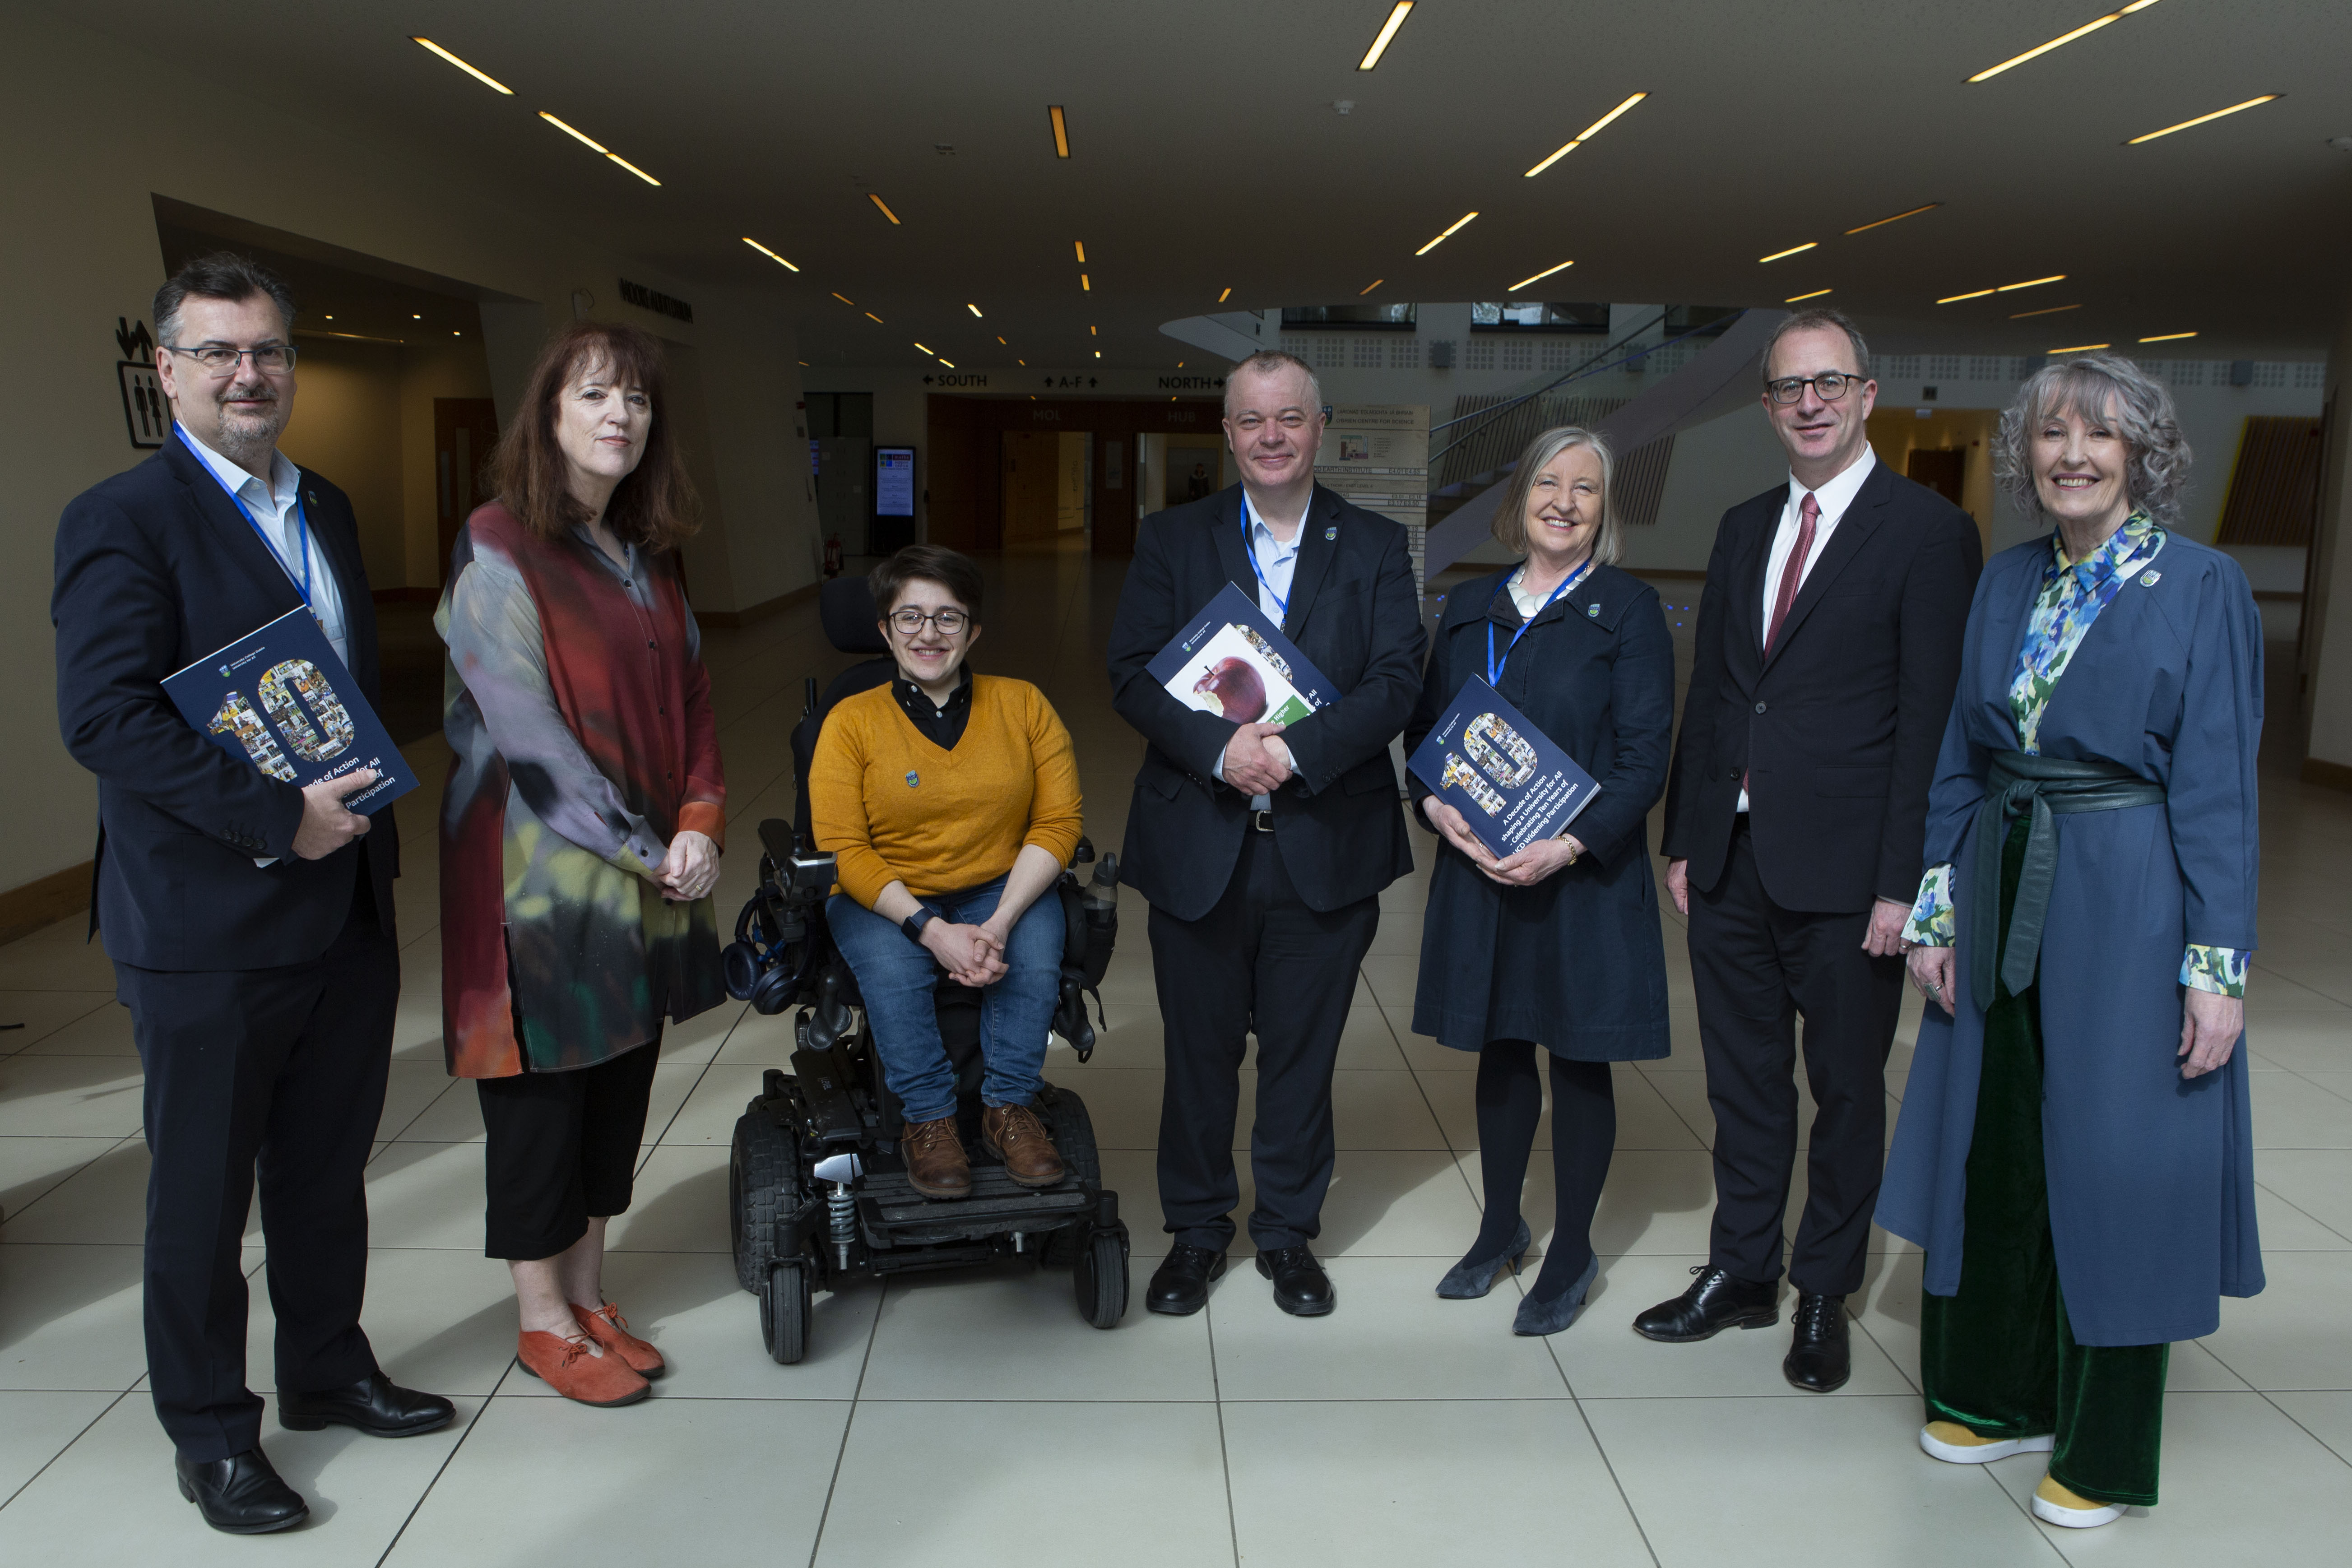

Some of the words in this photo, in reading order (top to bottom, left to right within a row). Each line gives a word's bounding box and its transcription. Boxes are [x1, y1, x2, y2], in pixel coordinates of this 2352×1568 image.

[938, 374, 987, 386] SOUTH
[1059, 376, 1082, 388] A-F
[1159, 376, 1211, 389] NORTH
[1033, 410, 1061, 421] MOL
[1168, 411, 1196, 422] HUB
[1309, 689, 1317, 699] All
[1315, 697, 1322, 706] of
[1273, 705, 1290, 721] Higher
[324, 770, 334, 781] of
[333, 757, 360, 775] Action
[369, 757, 380, 768] All
[1439, 713, 1537, 818] 10
[345, 777, 396, 809] Participation
[1507, 799, 1526, 821] Decade
[1525, 791, 1532, 801] of
[1530, 775, 1547, 795] Action
[1501, 819, 1522, 842] shaping
[1522, 787, 1549, 816] University
[1546, 779, 1555, 790] for
[1554, 770, 1563, 781] All
[1512, 812, 1541, 843] Celebrating
[1537, 802, 1549, 813] Ten
[1547, 787, 1562, 803] Years
[1561, 779, 1569, 788] of
[1523, 817, 1549, 844] Widening
[1546, 783, 1578, 819] Participation
